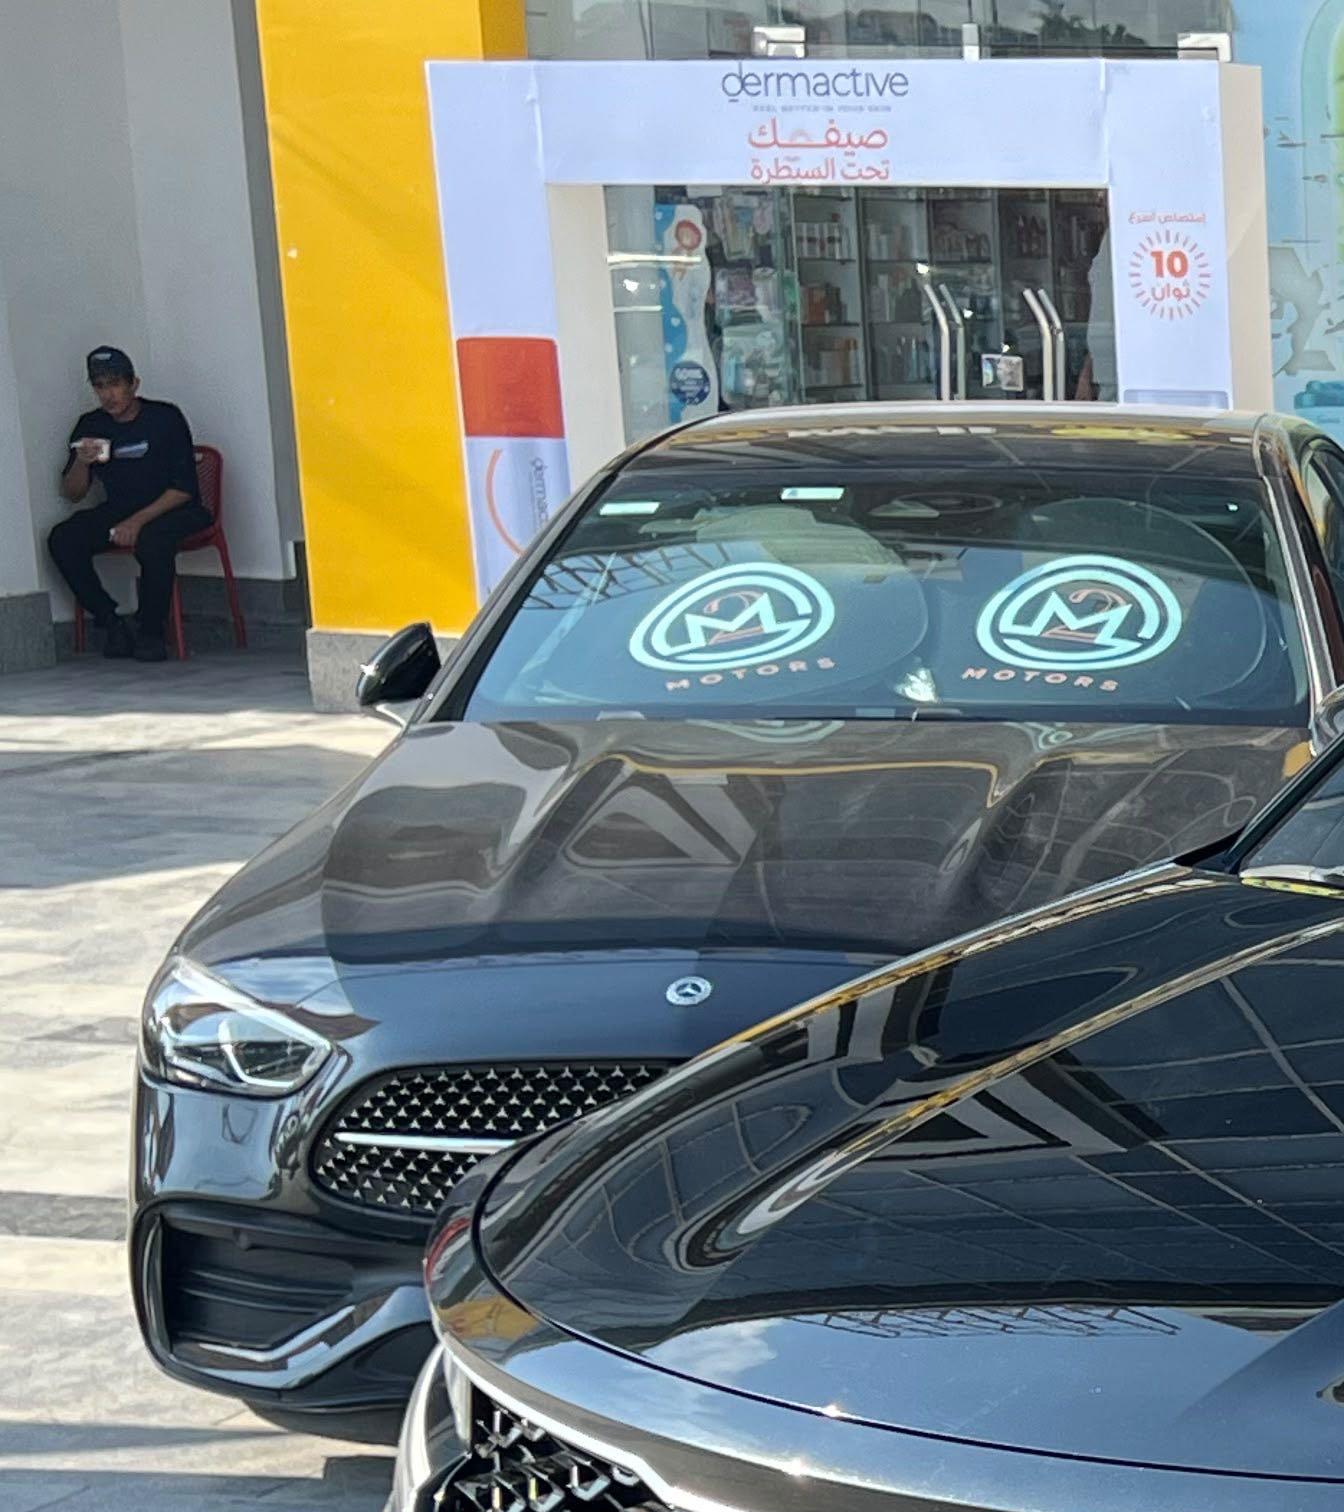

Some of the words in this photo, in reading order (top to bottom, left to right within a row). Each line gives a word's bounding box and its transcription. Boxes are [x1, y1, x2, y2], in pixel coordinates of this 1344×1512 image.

[722, 62, 909, 102] dermactive
[840, 159, 890, 180] تحت
[1151, 250, 1188, 278] 10
[665, 657, 835, 691] MOTORS
[961, 667, 1119, 691] MOTORS
